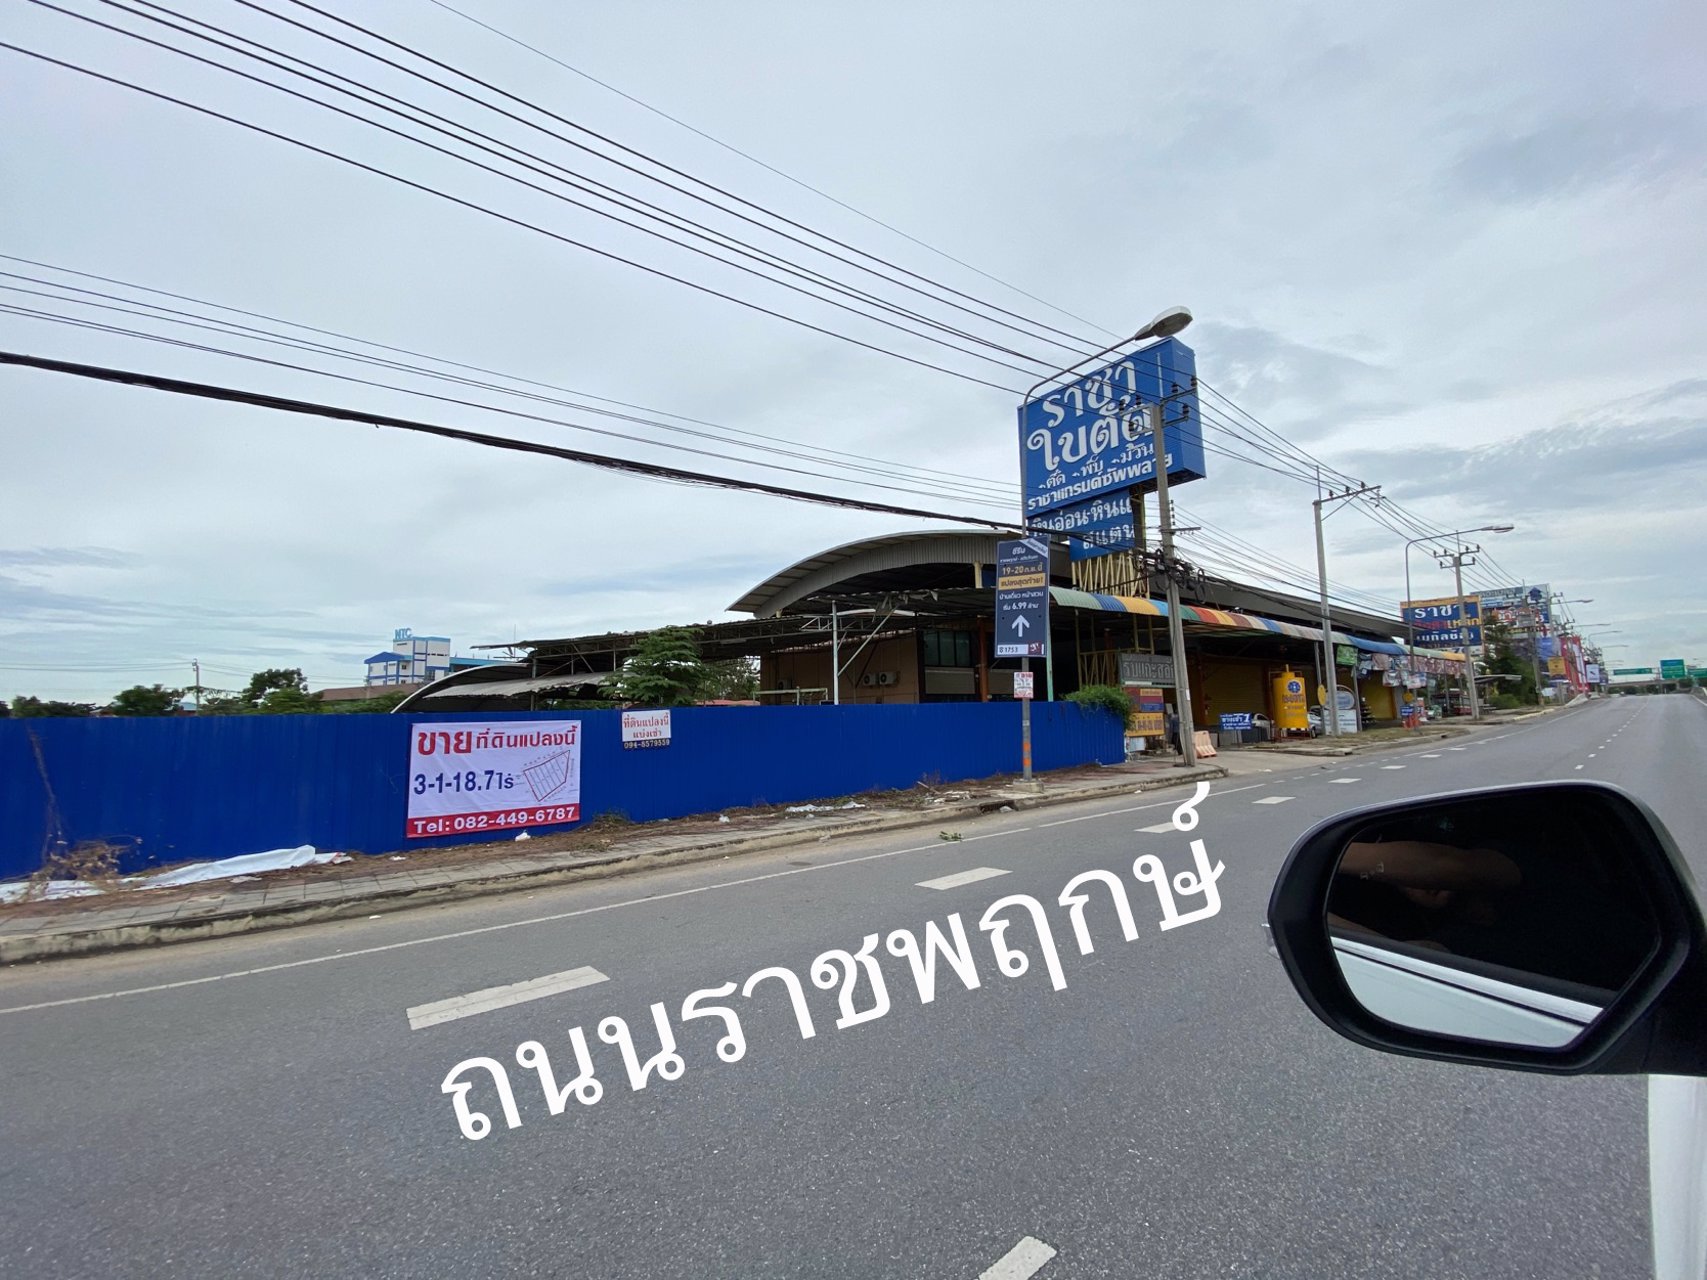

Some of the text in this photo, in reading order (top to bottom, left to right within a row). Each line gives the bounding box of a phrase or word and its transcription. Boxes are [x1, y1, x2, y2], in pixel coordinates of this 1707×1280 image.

[1042, 360, 1137, 428] ราชา
[1028, 452, 1173, 510] ราชาแกรนด์ซัพพลย
[1012, 601, 1027, 610] 6.99
[623, 712, 669, 728] ที่ดินแปลงนี้
[417, 725, 578, 756] ขาย ที่ดินแปลงนี้
[414, 807, 575, 834] Tel: 082-449-6787
